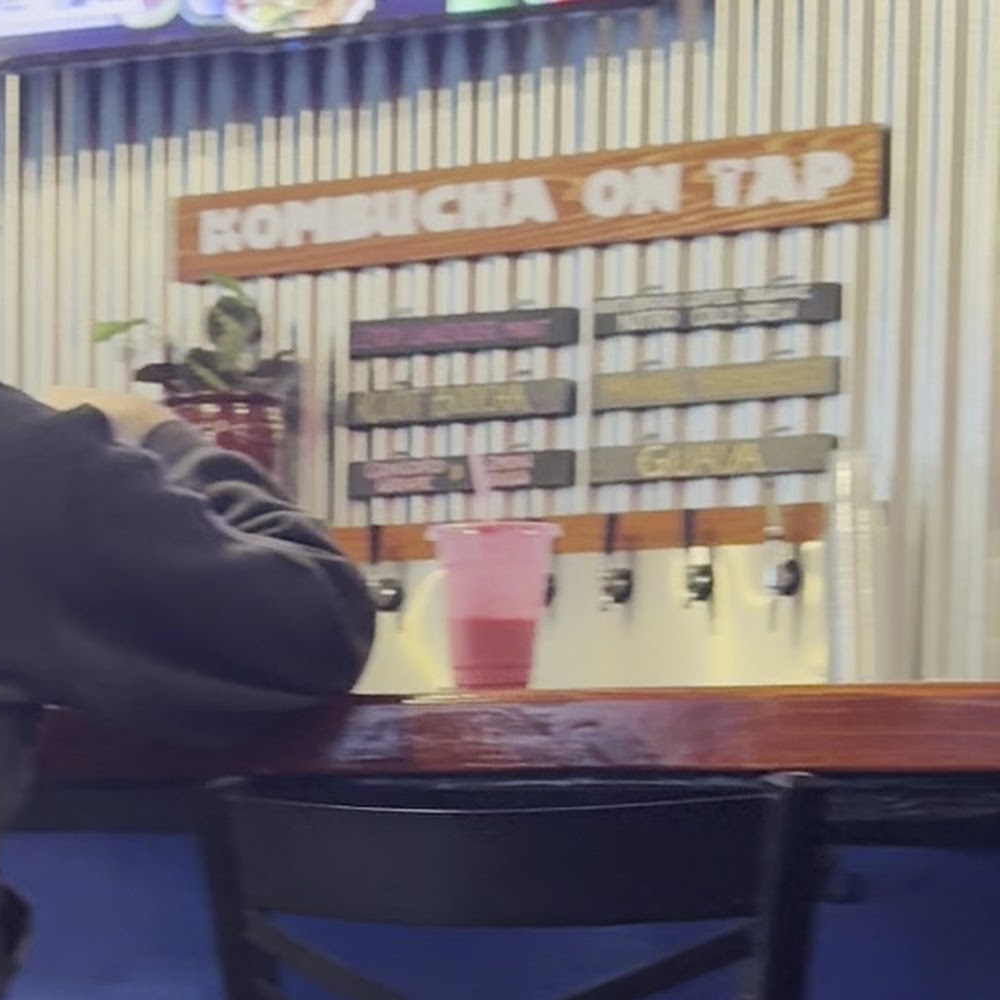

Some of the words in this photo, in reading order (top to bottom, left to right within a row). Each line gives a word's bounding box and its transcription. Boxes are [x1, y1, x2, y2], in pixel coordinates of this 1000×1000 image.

[197, 176, 558, 256] KOMBUCHA
[581, 163, 682, 219] ON
[706, 150, 853, 208] TAP
